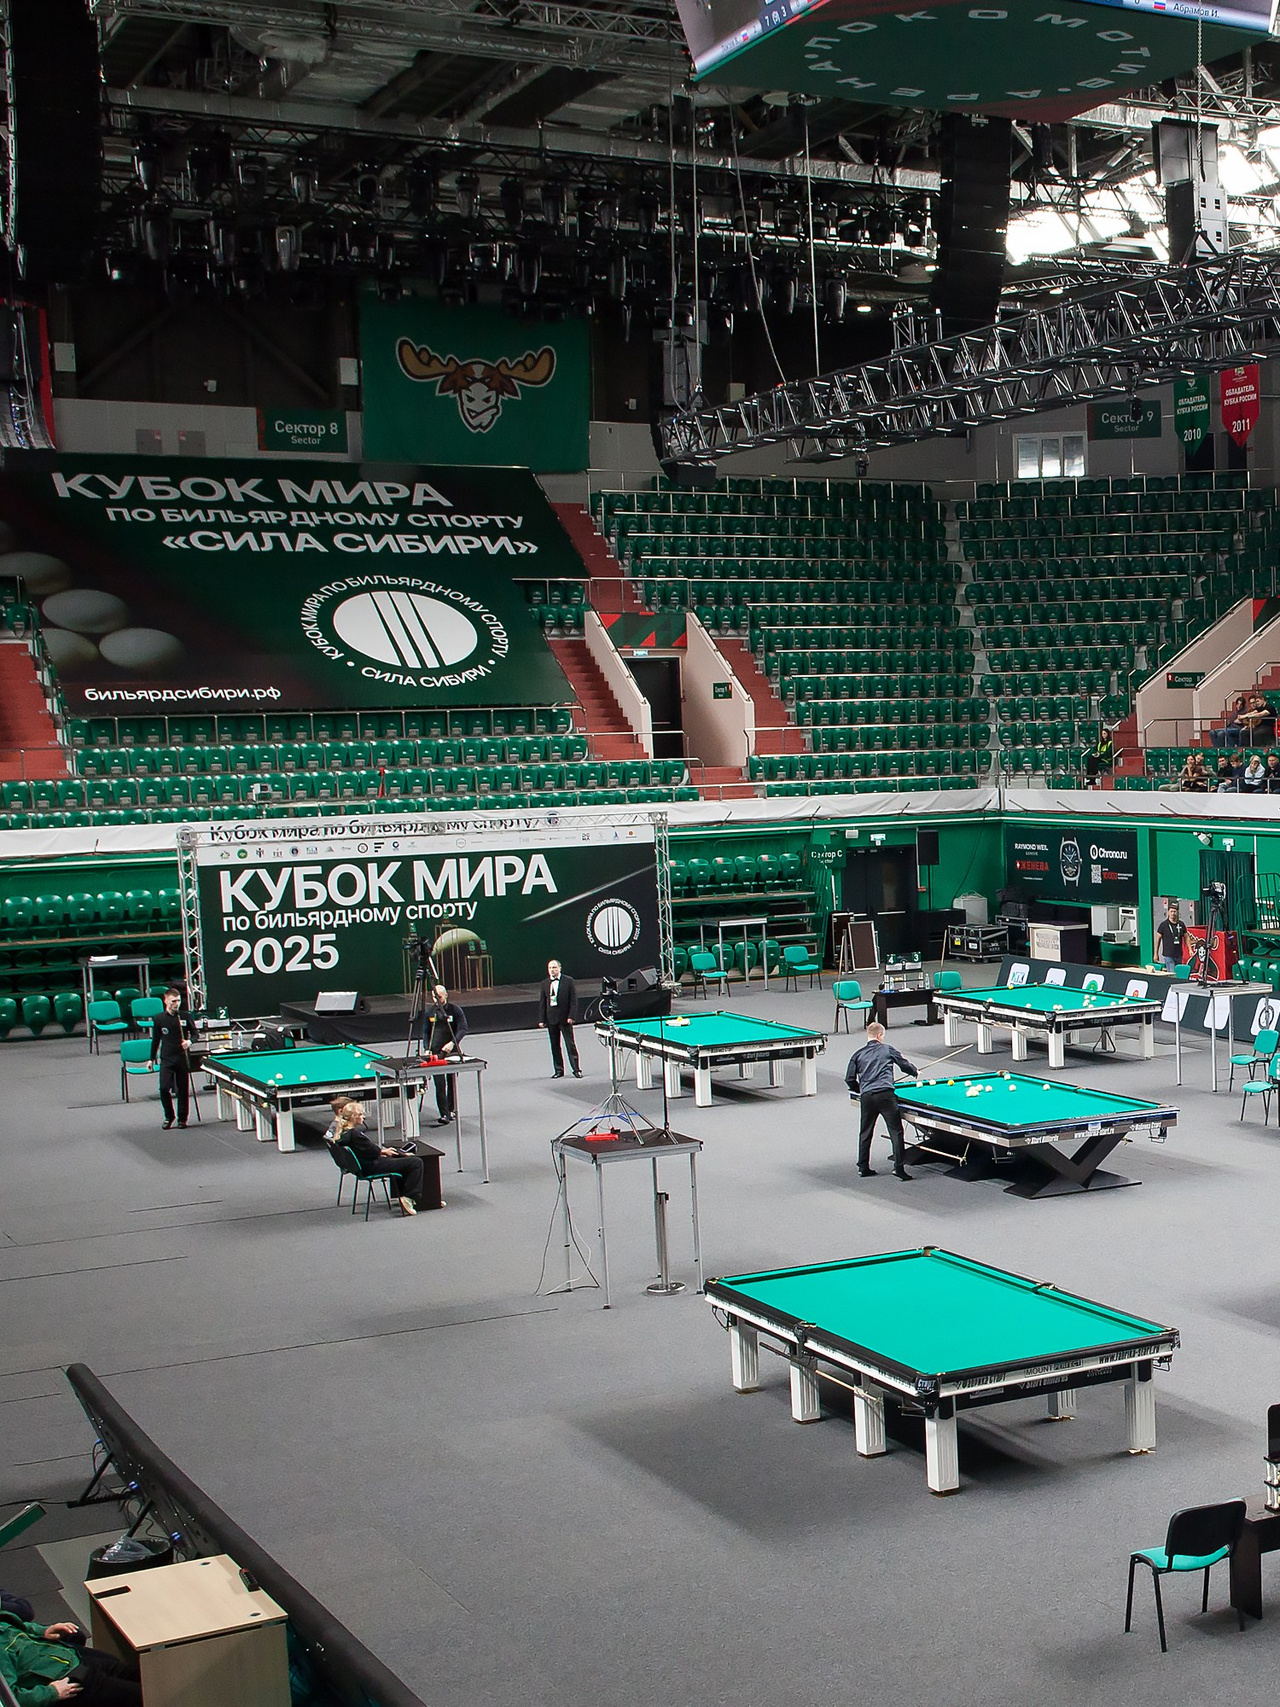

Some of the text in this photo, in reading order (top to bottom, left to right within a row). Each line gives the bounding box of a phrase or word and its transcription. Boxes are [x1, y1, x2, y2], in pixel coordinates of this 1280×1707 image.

[1225, 384, 1255, 397] ОБЛАДАТЕЛЬ
[1223, 393, 1258, 407] КУБКА РОССИИ
[1147, 410, 1154, 422] 9
[275, 420, 339, 436] Сектор 8
[1114, 424, 1140, 433] Sector
[1232, 419, 1251, 434] 2011
[291, 435, 321, 445] Sector
[1183, 427, 1202, 442] 2010
[51, 472, 454, 507] КУБОК МИРА
[105, 507, 524, 529] ПО БИЛЬЯРДНОМУ СПОРТУ
[162, 530, 539, 555] «СИЛА СИБИРИ»
[301, 575, 509, 660] КУБОК МИРА ПО БИЛЬЯРДНОМУ СПОРТУ
[361, 664, 492, 688] СИЛА СИБИРИ
[84, 686, 281, 703] бильярдсибири.рф
[1099, 848, 1128, 859] Chrono.ru
[219, 853, 558, 914] КУБОК МИРА
[223, 901, 478, 932] по бильярдному спорту
[224, 933, 340, 976] 2025
[914, 953, 919, 962] 3
[219, 1009, 226, 1019] 2
